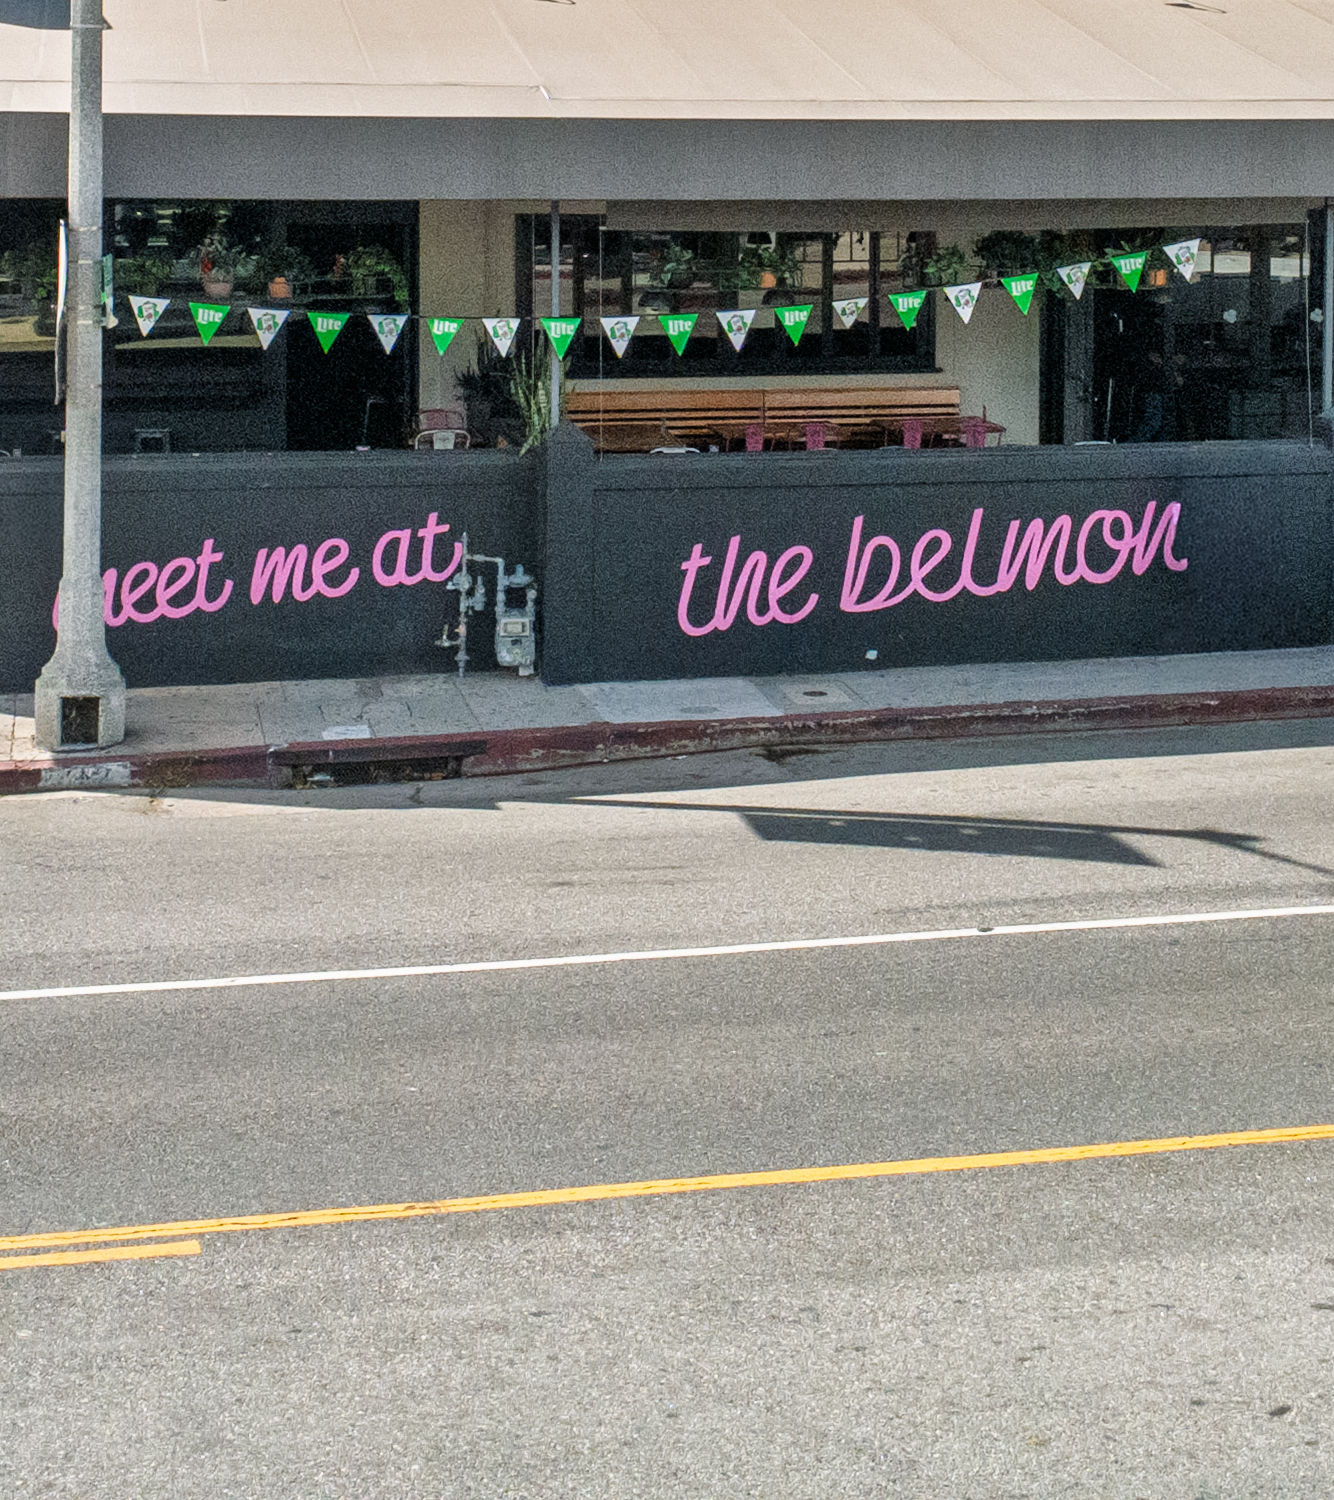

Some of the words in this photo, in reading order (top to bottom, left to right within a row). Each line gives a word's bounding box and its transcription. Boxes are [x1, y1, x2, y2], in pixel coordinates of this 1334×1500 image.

[1120, 257, 1143, 274] Lite
[1011, 279, 1034, 296] Lite
[898, 295, 922, 312] Lite
[197, 307, 223, 325] Lite
[317, 316, 342, 333] Lite
[784, 308, 808, 325] Lite
[433, 317, 458, 335] Lite
[550, 321, 575, 338] Lite
[668, 318, 693, 335] Lite
[249, 538, 361, 604] me
[372, 512, 464, 586] at
[677, 535, 819, 637] the
[840, 501, 1188, 612] belmon
